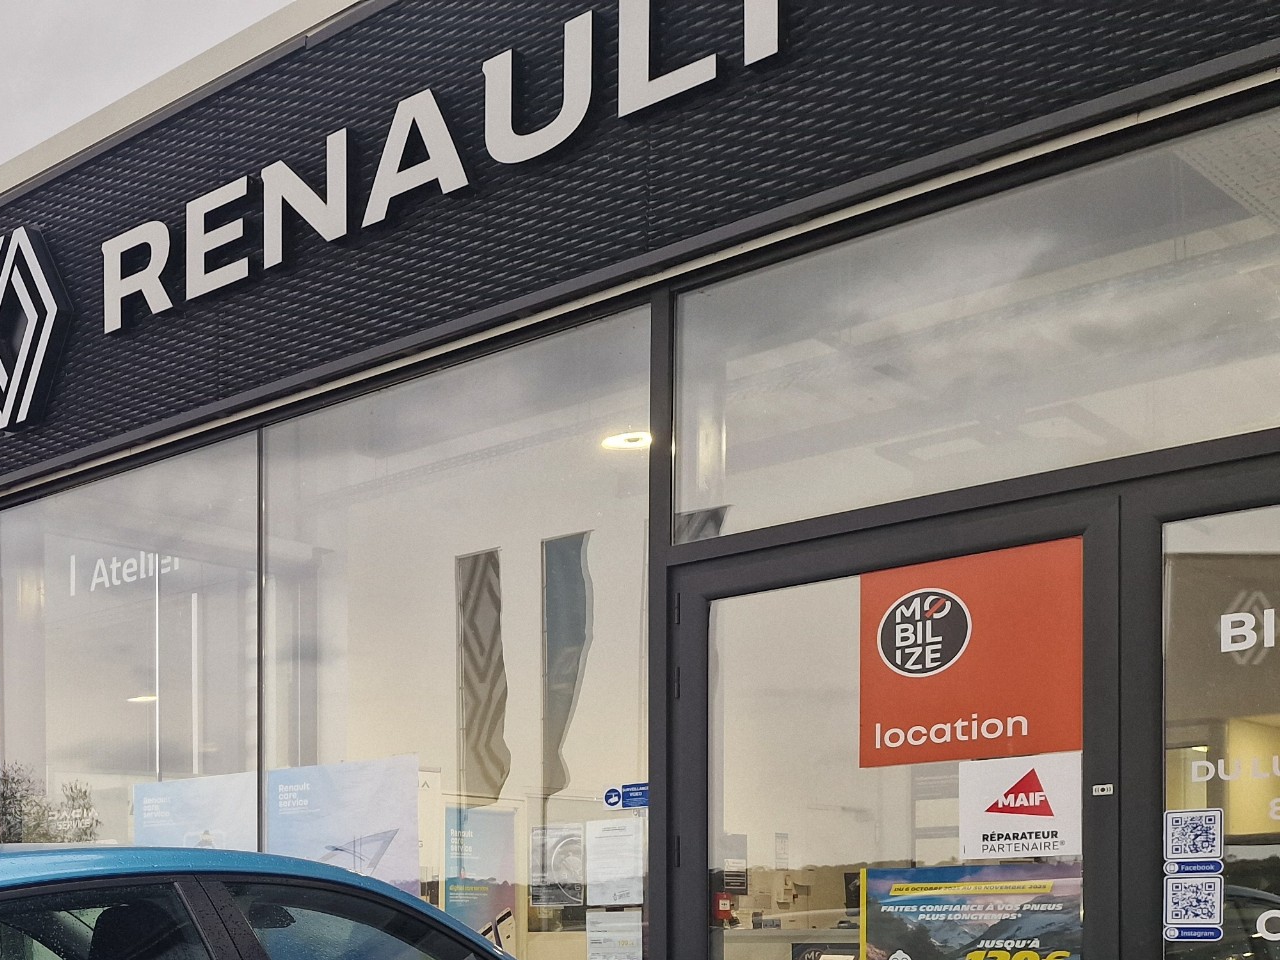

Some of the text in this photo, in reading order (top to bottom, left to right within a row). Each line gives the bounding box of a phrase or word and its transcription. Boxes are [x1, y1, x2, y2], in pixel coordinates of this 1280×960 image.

[895, 619, 943, 648] BIL
[895, 643, 942, 670] IZE
[875, 713, 1028, 749] location
[1192, 758, 1241, 782] DU
[998, 791, 1046, 808] MAIF
[982, 830, 1059, 842] RÉPARATEUR
[1181, 864, 1215, 872] Facebook
[919, 904, 983, 912] CONFIANCE
[985, 902, 994, 911] À
[1022, 903, 1063, 911] PNEUS
[1181, 929, 1215, 939] Instagram
[977, 938, 1040, 950] JUSQU'À
